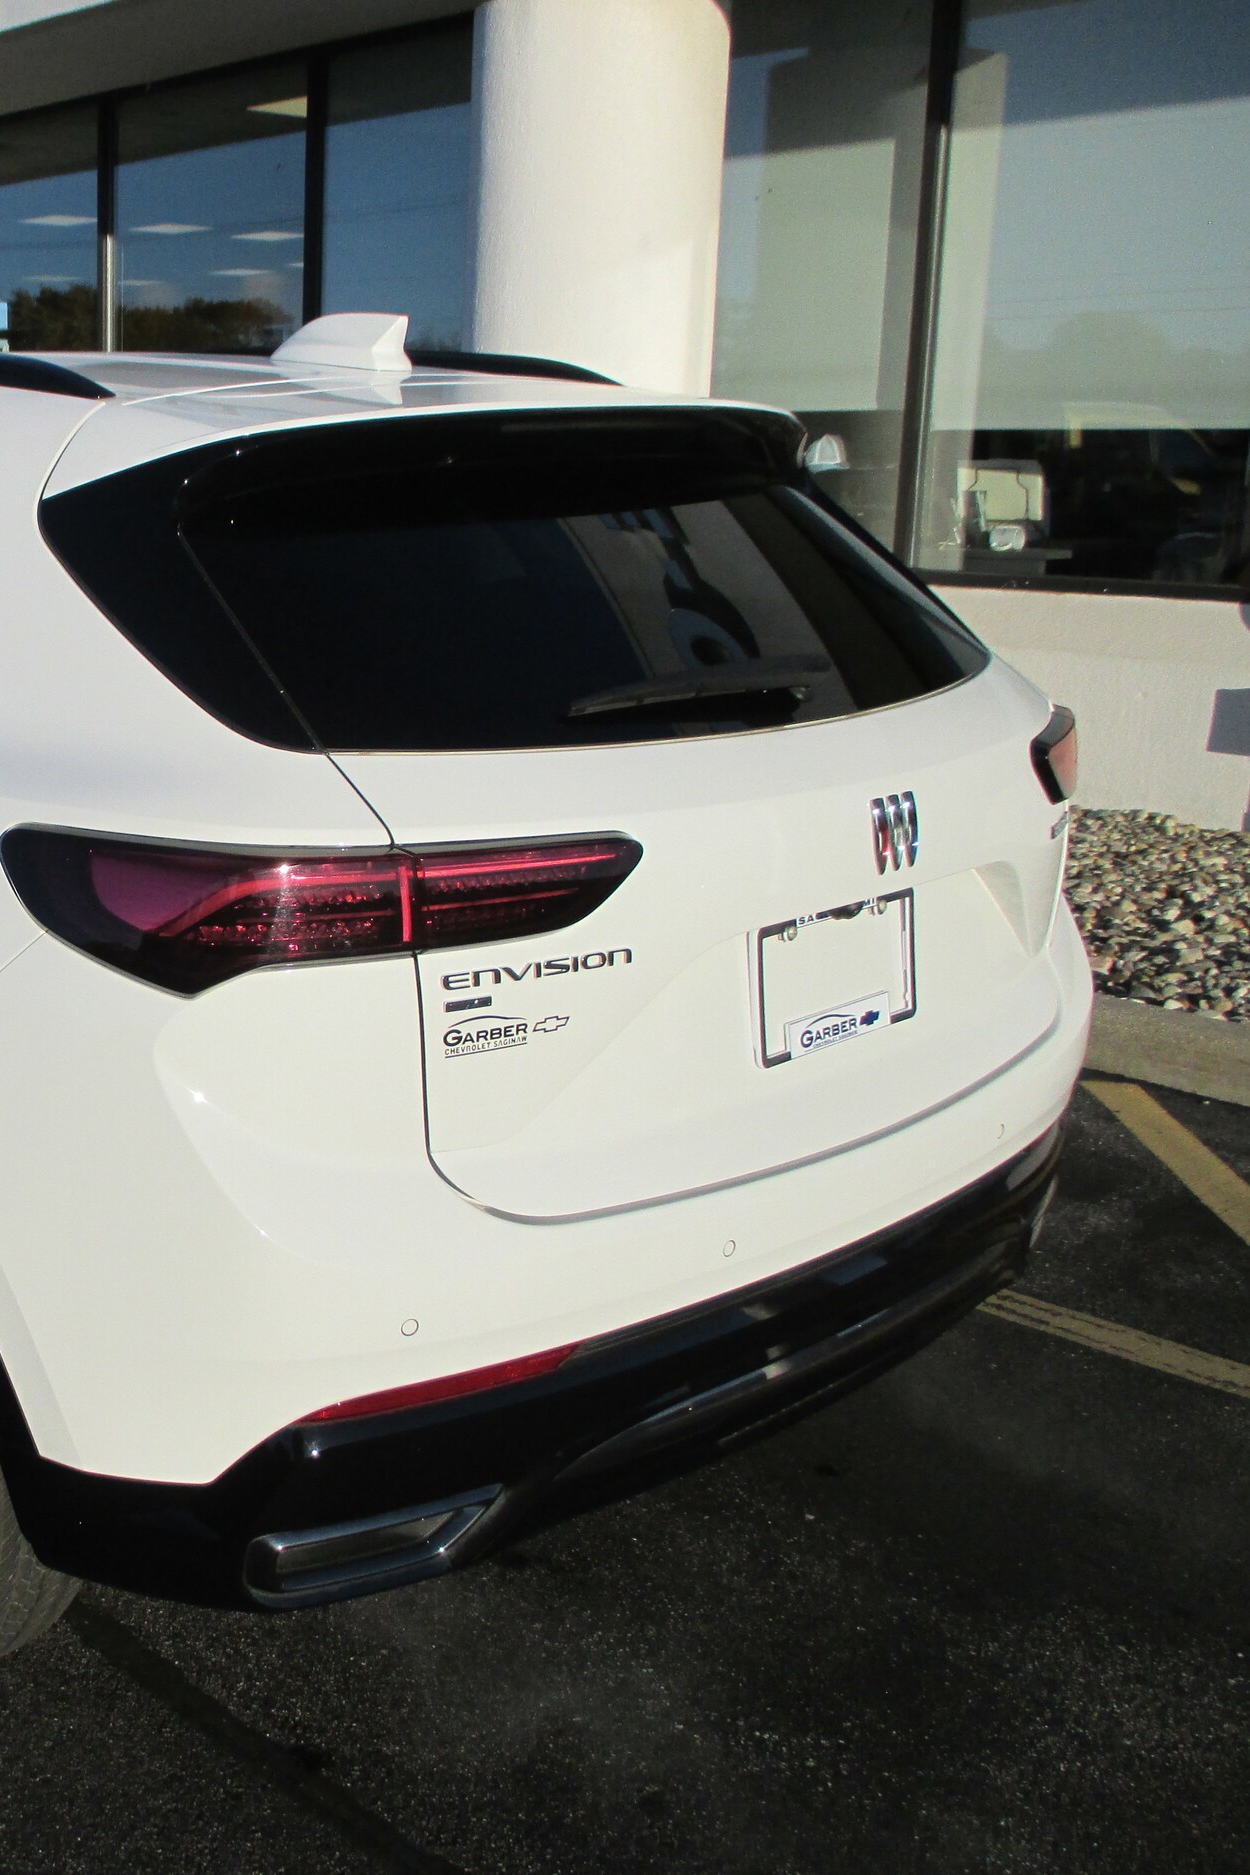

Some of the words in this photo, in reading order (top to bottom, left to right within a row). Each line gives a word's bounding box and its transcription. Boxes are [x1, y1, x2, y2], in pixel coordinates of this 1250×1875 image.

[441, 947, 633, 991] ENVISION
[442, 1022, 528, 1047] GARBER
[444, 1041, 491, 1056] CHEVROLET
[493, 1035, 528, 1048] SAGINAW
[800, 1017, 858, 1048] GARBER
